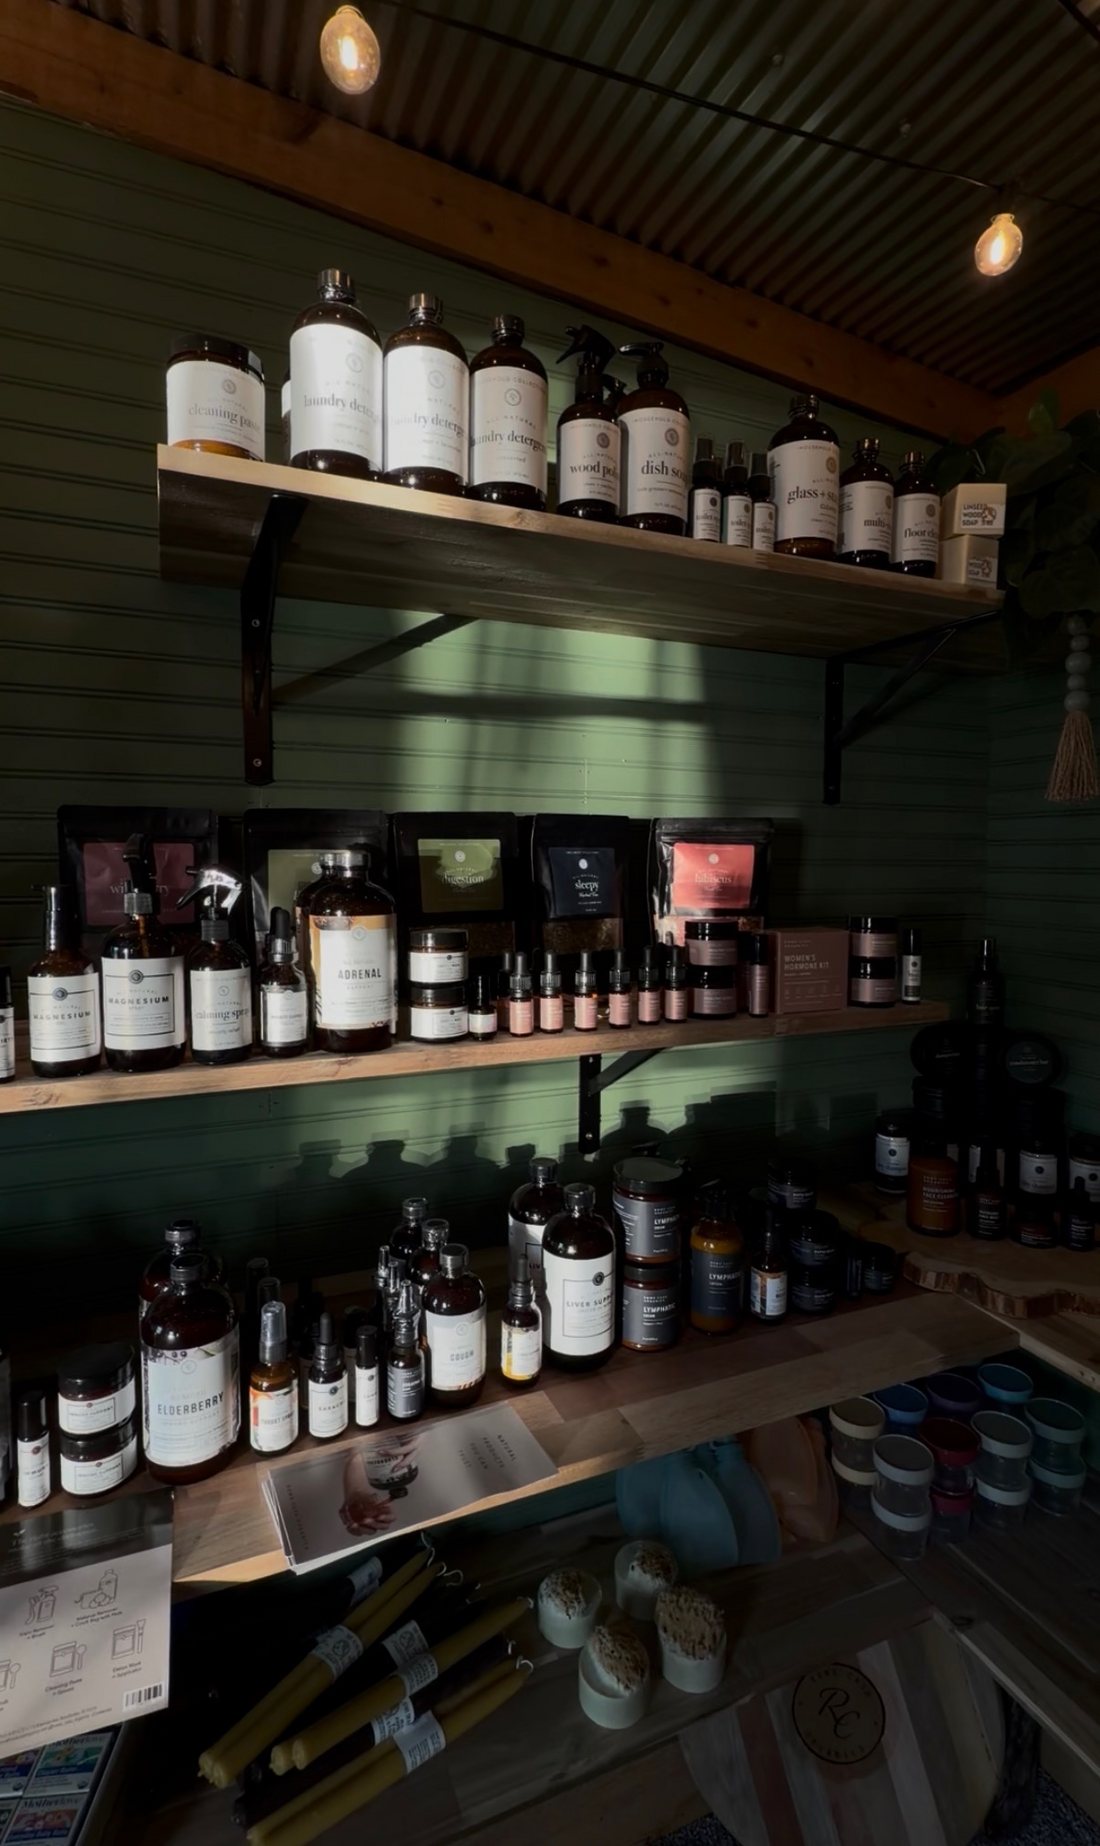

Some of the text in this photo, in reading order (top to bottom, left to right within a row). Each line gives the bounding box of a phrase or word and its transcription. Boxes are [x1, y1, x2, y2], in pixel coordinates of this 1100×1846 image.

[303, 393, 346, 412] laundry
[188, 402, 238, 425] cleaning
[569, 461, 600, 474] wood
[640, 460, 669, 475] dish
[787, 486, 819, 504] glass
[904, 528, 926, 538] floor
[695, 872, 732, 884] hibiscus
[575, 879, 599, 892] sleepy
[784, 954, 816, 962] WOMEN'S
[784, 962, 818, 970] HORMONE
[338, 968, 382, 980] ADRENAL
[108, 996, 169, 1005] MAGNESIUM
[33, 1010, 91, 1021] MAGNESIUM
[450, 1350, 474, 1361] COUGH
[157, 1391, 225, 1416] ELDERBERRY
[497, 1434, 517, 1462] NATURAL
